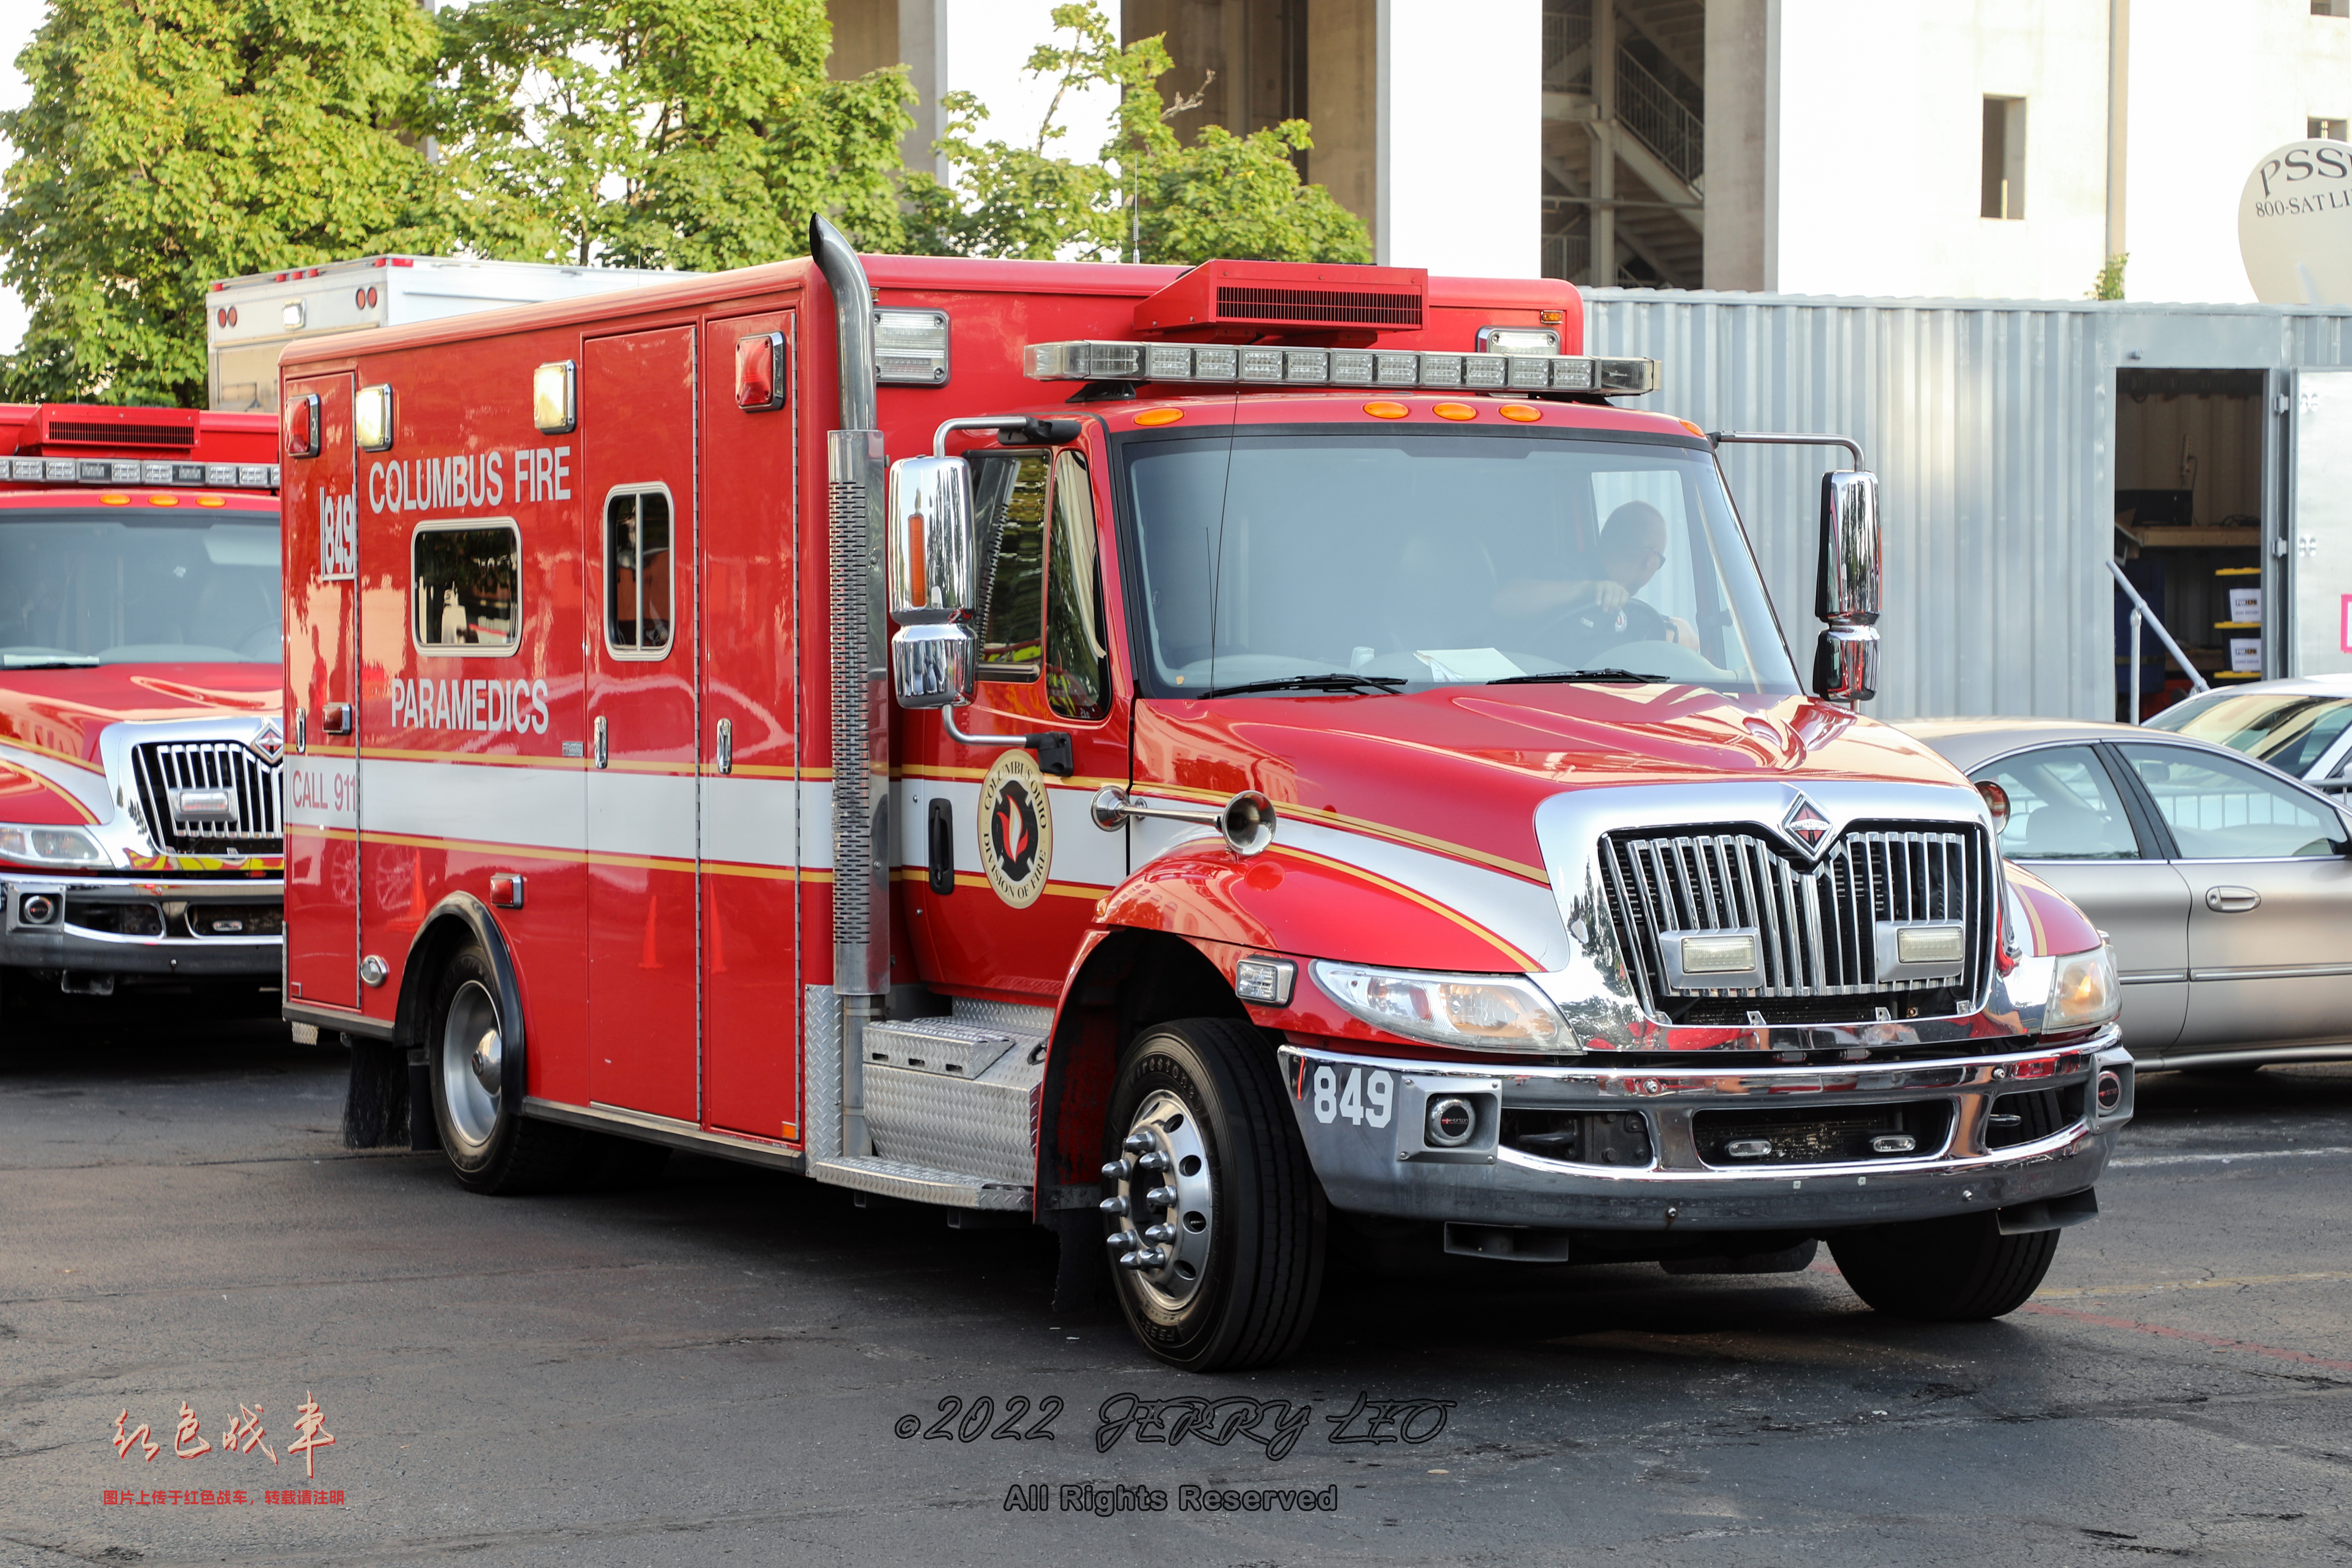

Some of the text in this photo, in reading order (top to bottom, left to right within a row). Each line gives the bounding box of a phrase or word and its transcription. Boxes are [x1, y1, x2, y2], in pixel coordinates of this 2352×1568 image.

[2255, 189, 2352, 218] 800-SATLI
[369, 446, 571, 514] COLUMBUS FIRE
[325, 494, 353, 574] 849
[391, 678, 549, 735] PARAMEDICS
[292, 770, 356, 812] CALL 911
[984, 761, 1047, 829] COLUMBUS OHIO
[984, 833, 1046, 899] DIVISION OF FIRE
[1314, 1065, 1394, 1129] 849
